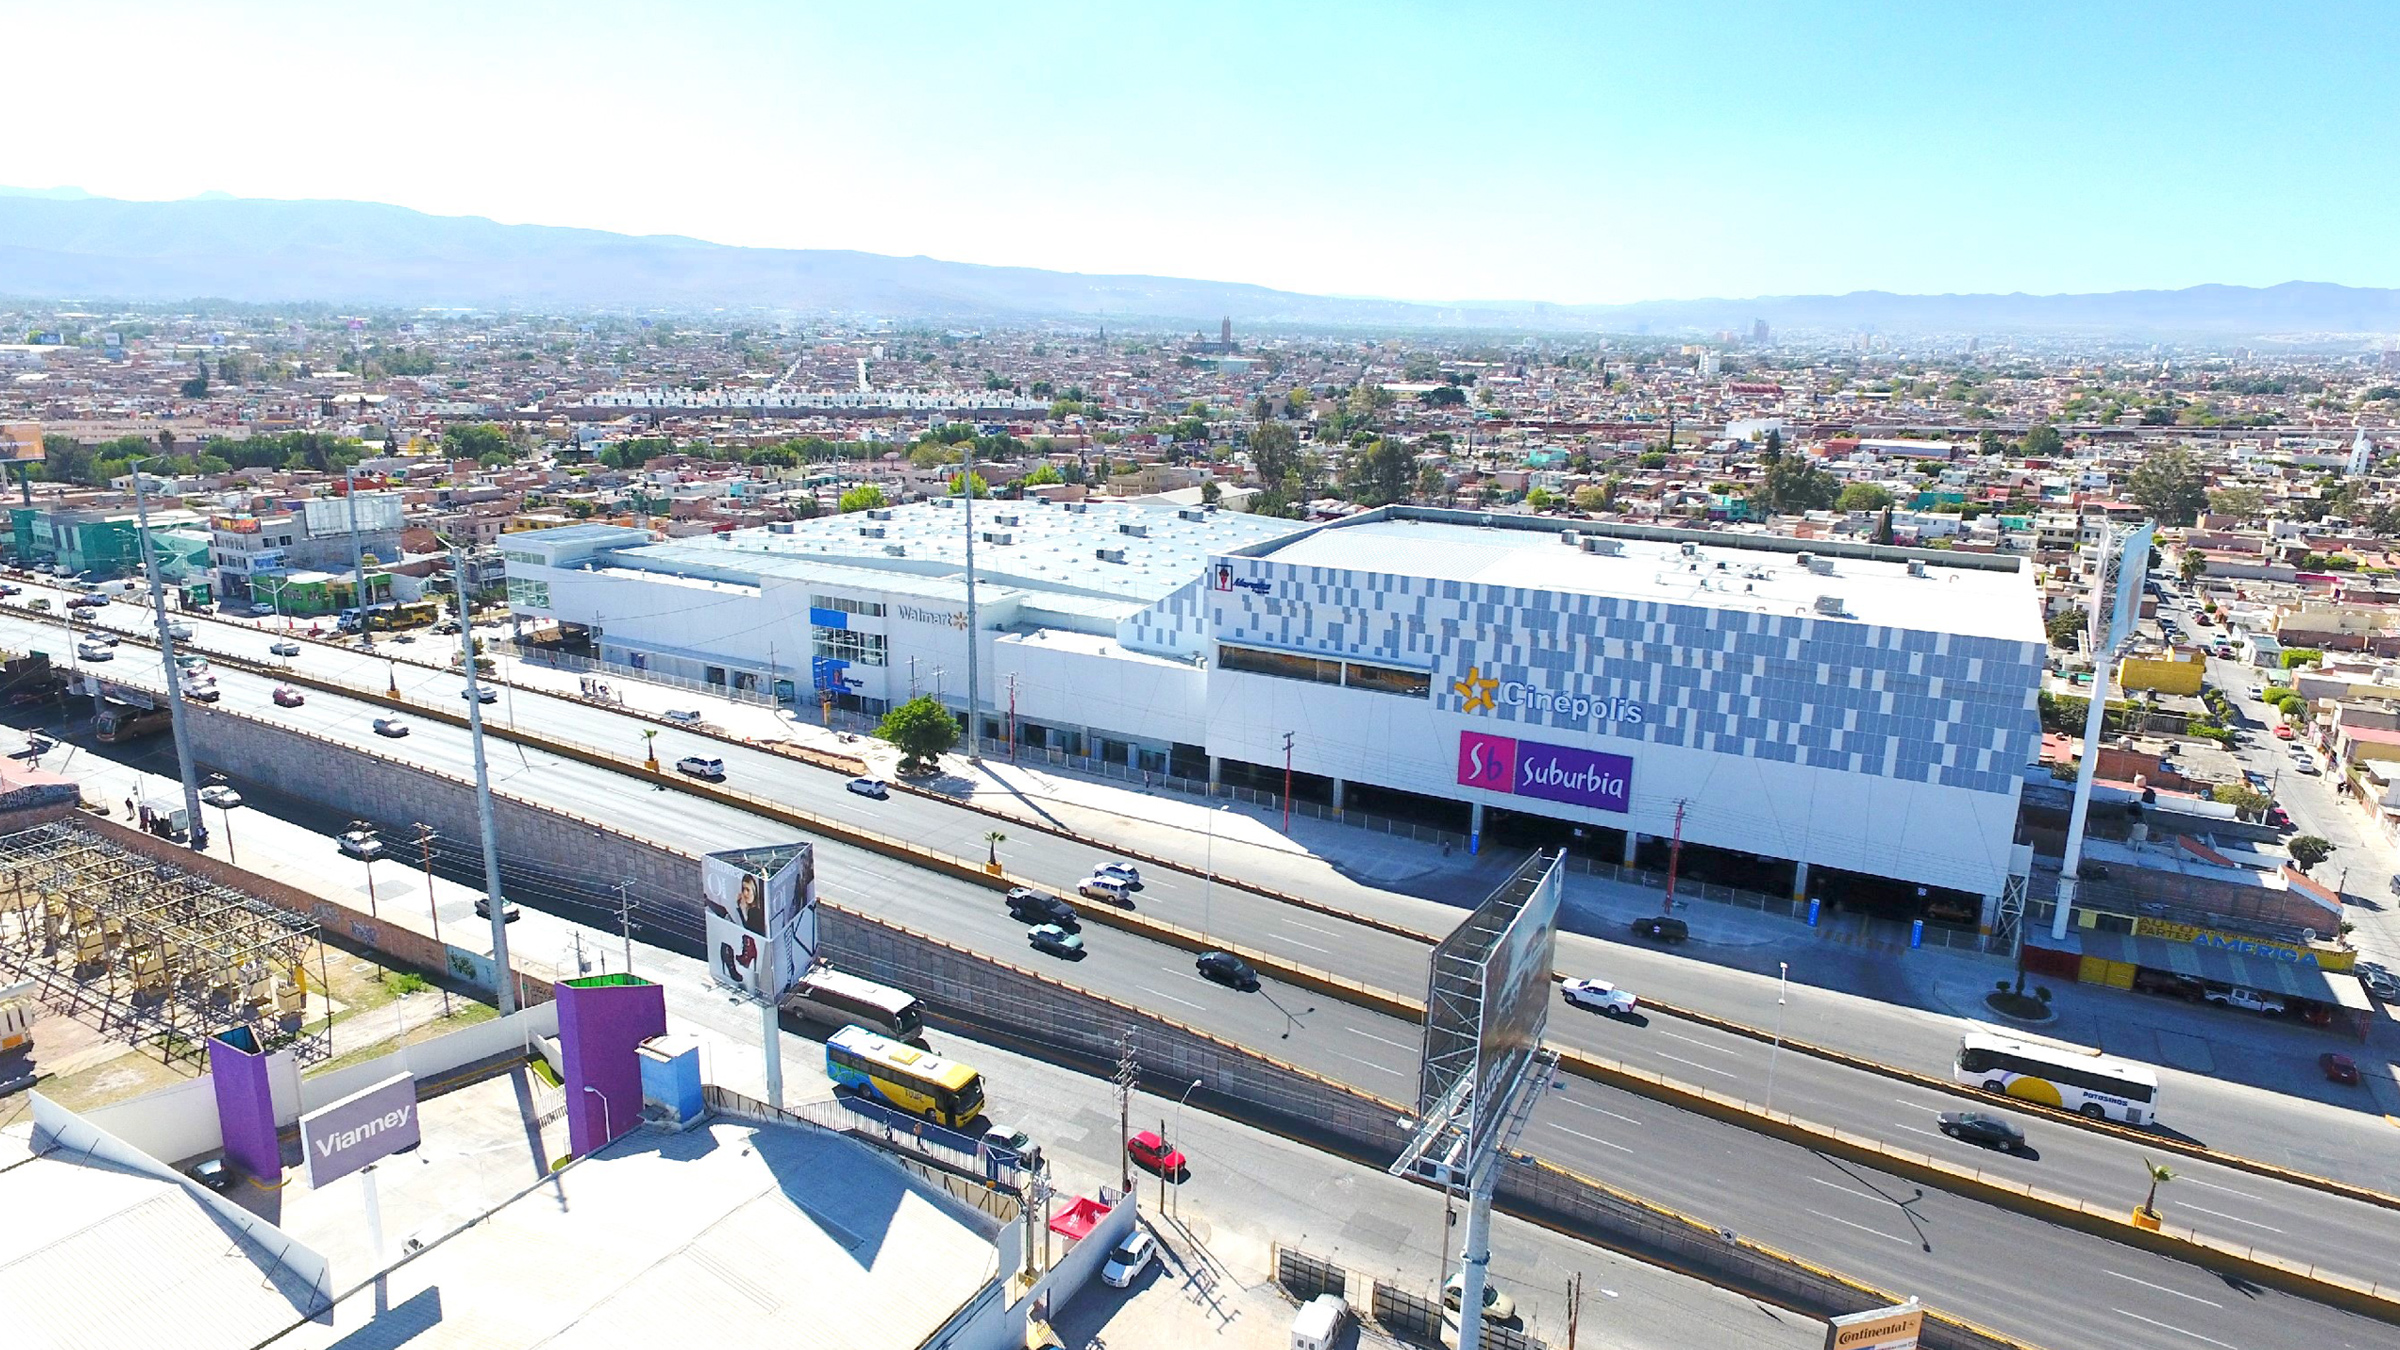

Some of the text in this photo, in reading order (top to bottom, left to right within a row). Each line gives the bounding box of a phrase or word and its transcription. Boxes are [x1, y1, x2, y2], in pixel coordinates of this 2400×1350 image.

[898, 605, 952, 627] Walmart
[1502, 681, 1642, 724] Cinépolis
[1522, 756, 1624, 799] Suburbia
[2138, 925, 2192, 942] PARTES
[315, 1105, 410, 1158] Vianney
[1838, 1321, 1907, 1344] Continental
